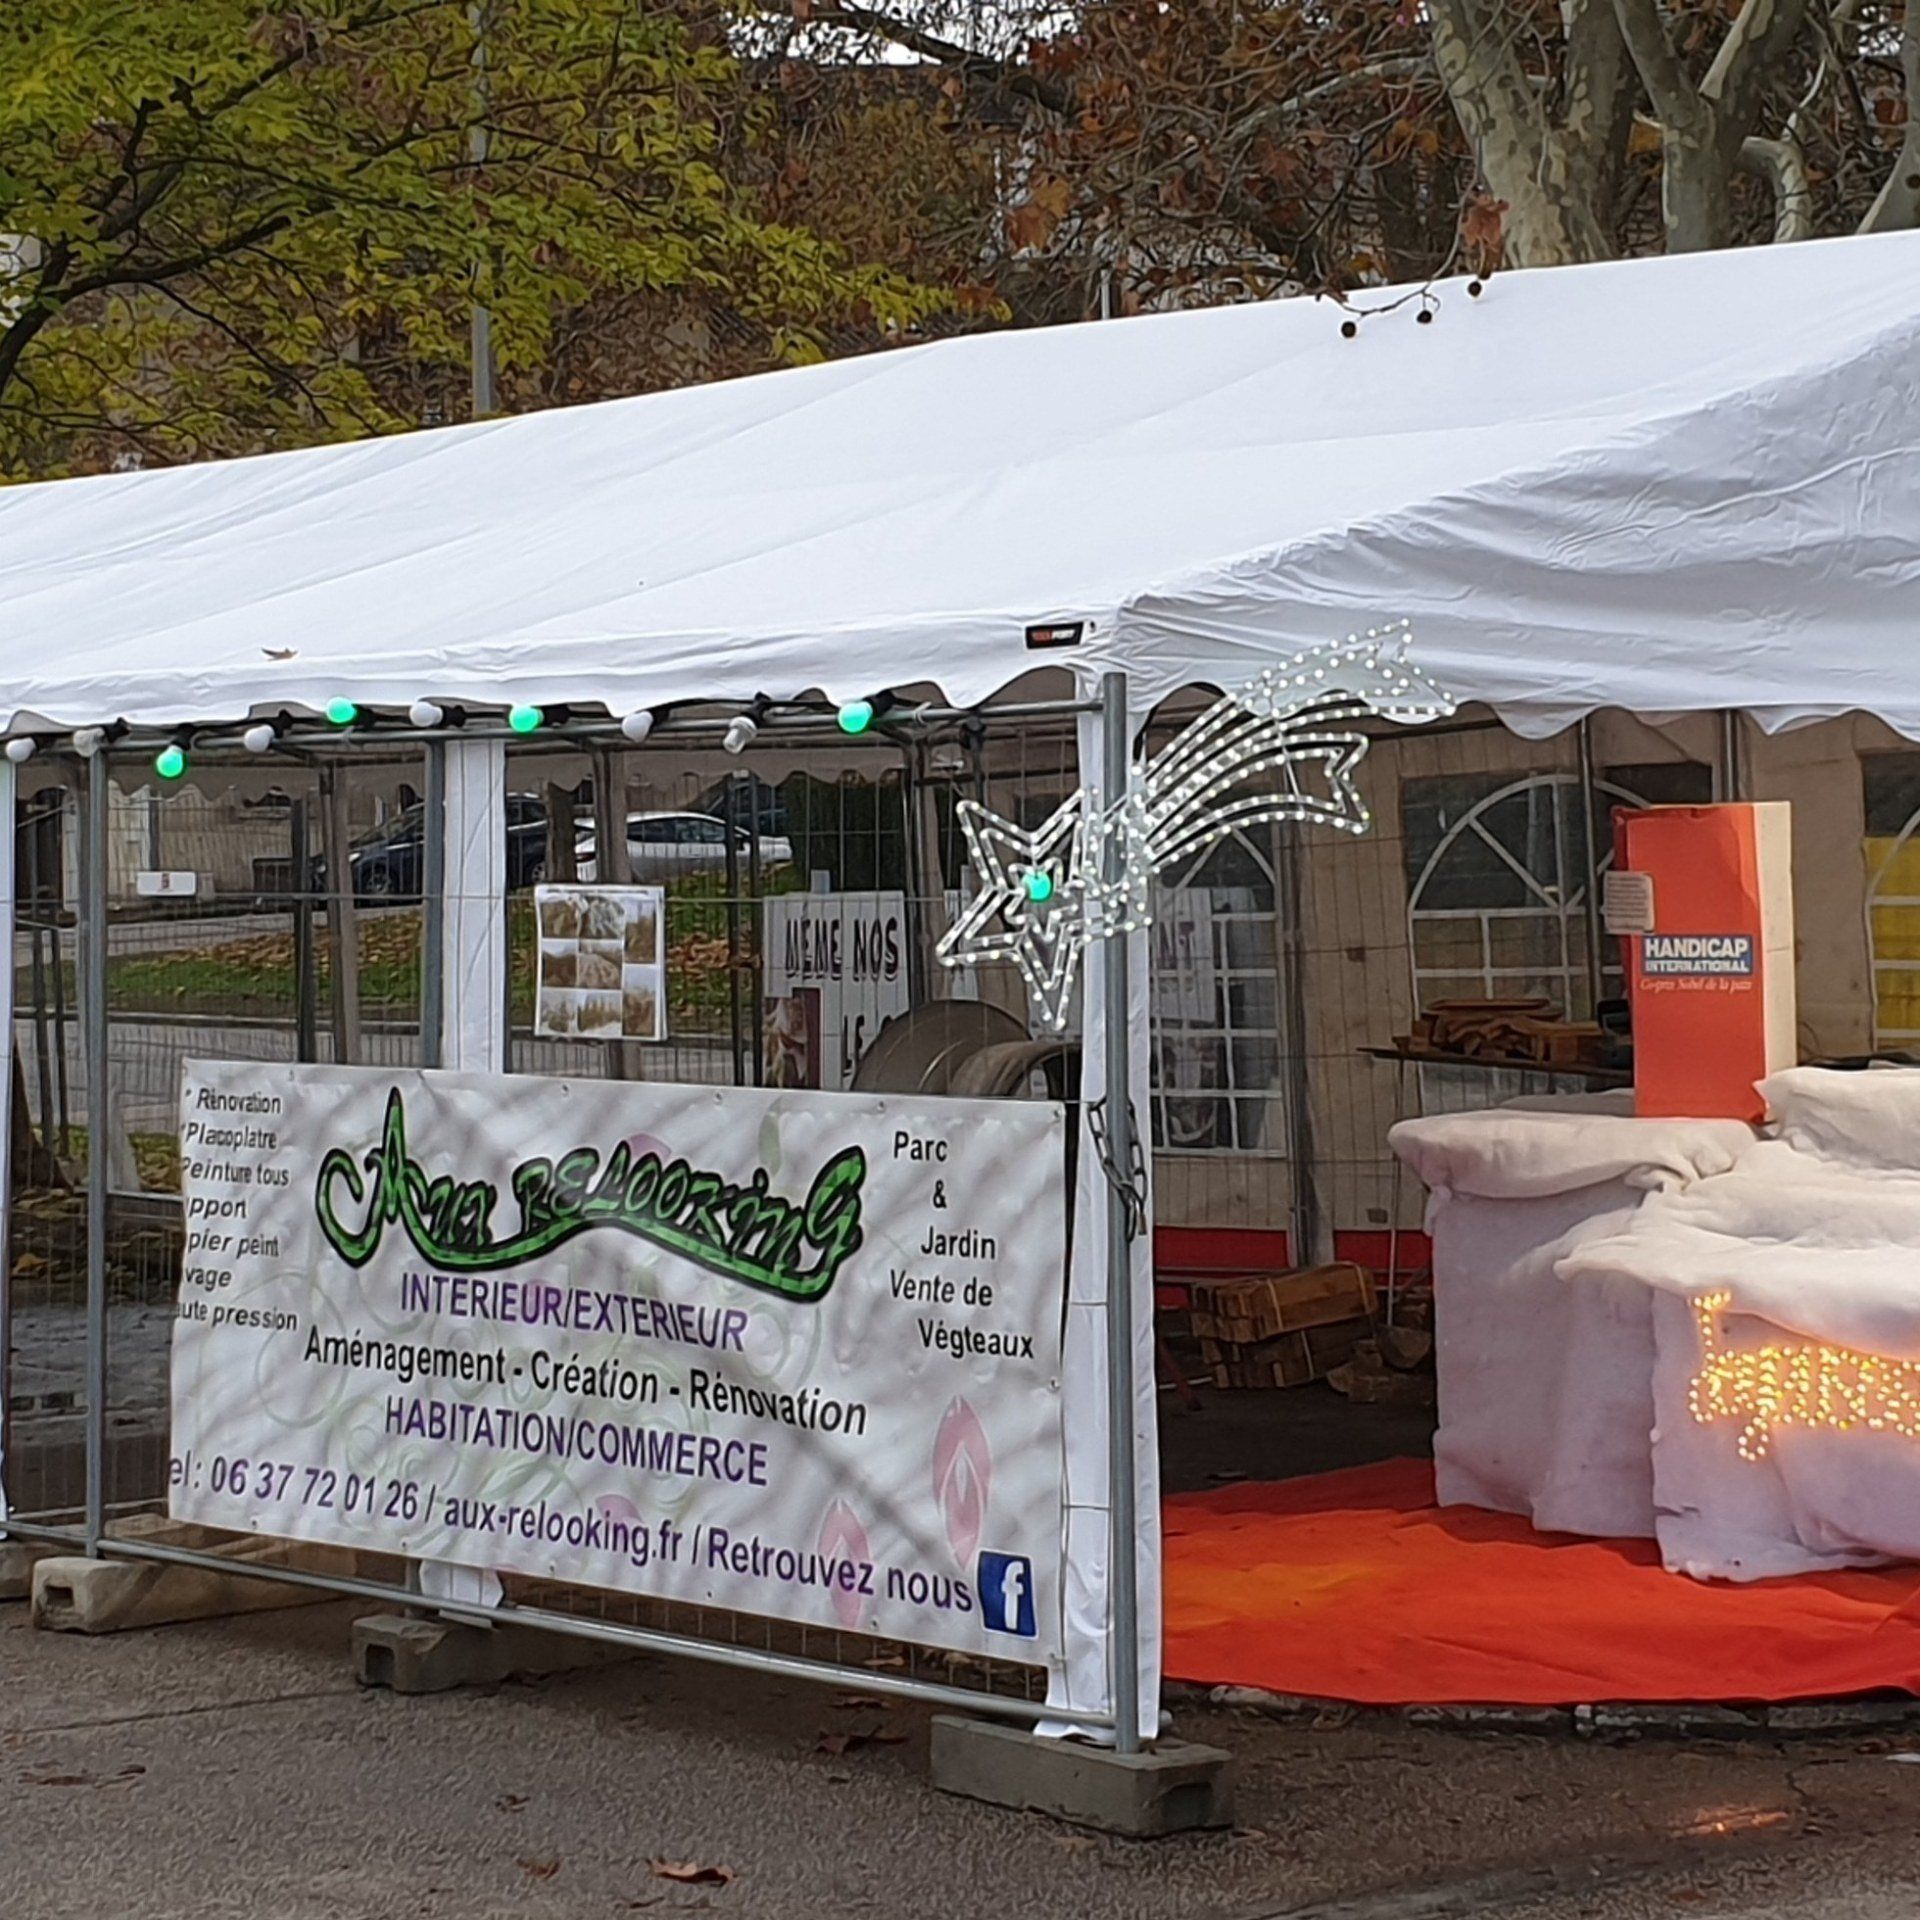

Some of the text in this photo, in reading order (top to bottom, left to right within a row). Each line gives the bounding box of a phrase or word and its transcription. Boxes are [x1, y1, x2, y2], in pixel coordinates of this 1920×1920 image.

[852, 915, 899, 982] NOS
[1645, 937, 1749, 958] HANDICAP
[1645, 960, 1750, 972] INTERNATIONAL
[893, 1131, 948, 1162] Parc
[257, 1163, 289, 1187] tous
[933, 1179, 947, 1209] &
[236, 1233, 280, 1260] peint
[920, 1226, 996, 1260] Jardin
[890, 1268, 993, 1307] Vente de
[211, 1304, 298, 1332] pression
[401, 1272, 748, 1351] INTERIEUR/EXTERIEUR
[918, 1318, 1034, 1360] Végteaux
[304, 1324, 506, 1385] Aménagement
[531, 1349, 659, 1404] Création
[690, 1368, 868, 1436] Rénovation
[385, 1394, 769, 1487] HABITATION/COMMERCE
[210, 1456, 249, 1496] 06
[254, 1461, 294, 1502] 37
[301, 1467, 337, 1508] 72
[344, 1473, 376, 1515] 01
[384, 1479, 419, 1521] 26
[444, 1496, 683, 1568] aux-relooking.fr
[707, 1526, 875, 1596] Retrouvez
[886, 1563, 973, 1613] nous
